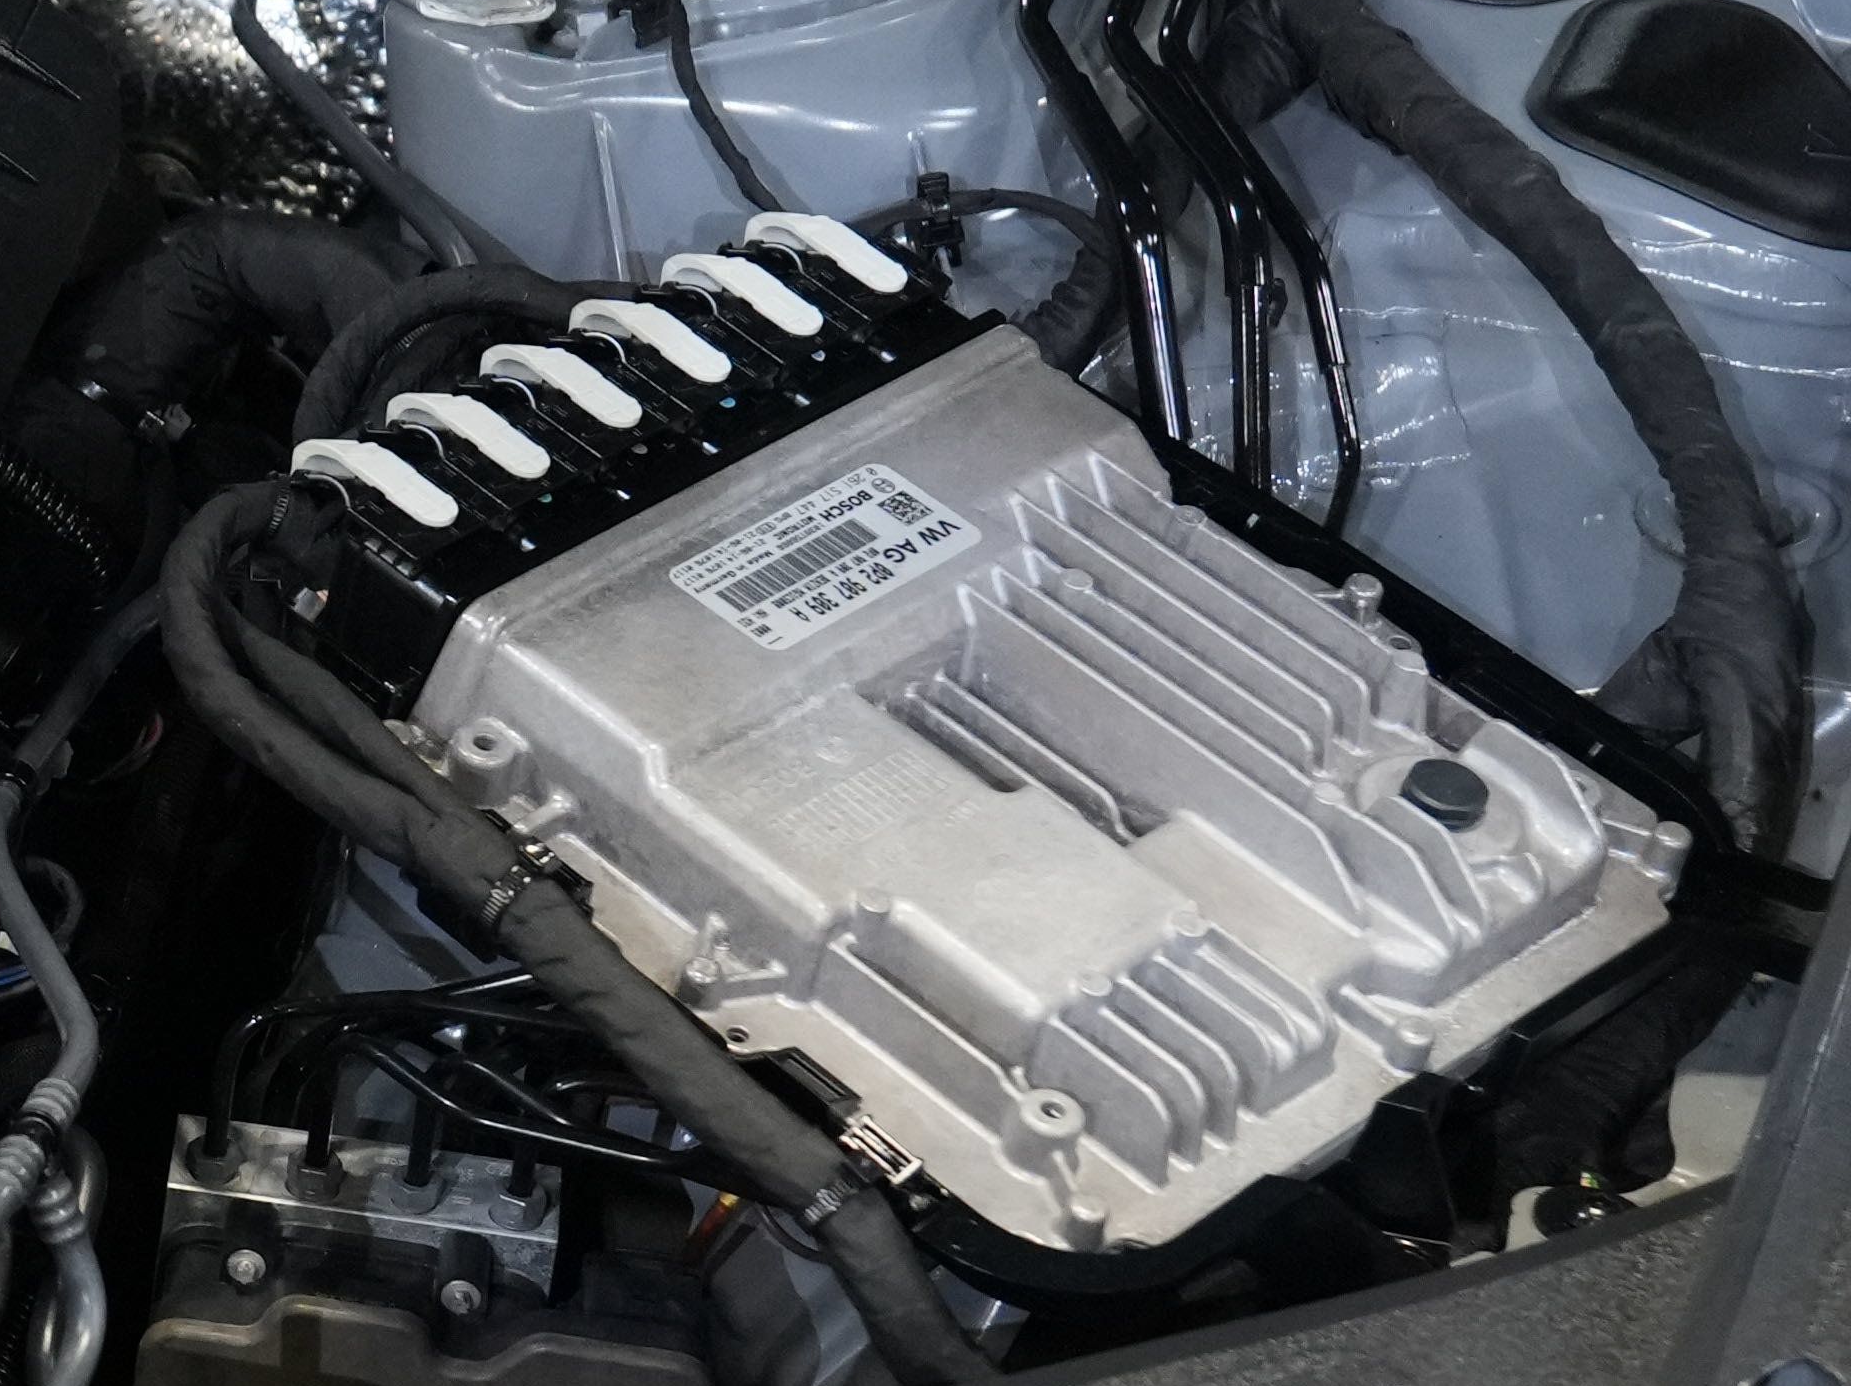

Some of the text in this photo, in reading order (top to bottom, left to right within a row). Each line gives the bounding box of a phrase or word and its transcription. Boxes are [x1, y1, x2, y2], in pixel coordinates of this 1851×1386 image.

[818, 489, 874, 522] BOSCH
[746, 549, 775, 565] Made
[877, 519, 961, 563] VW AG
[693, 570, 737, 594] Germany
[789, 561, 895, 622] 0P2 907 309 A
